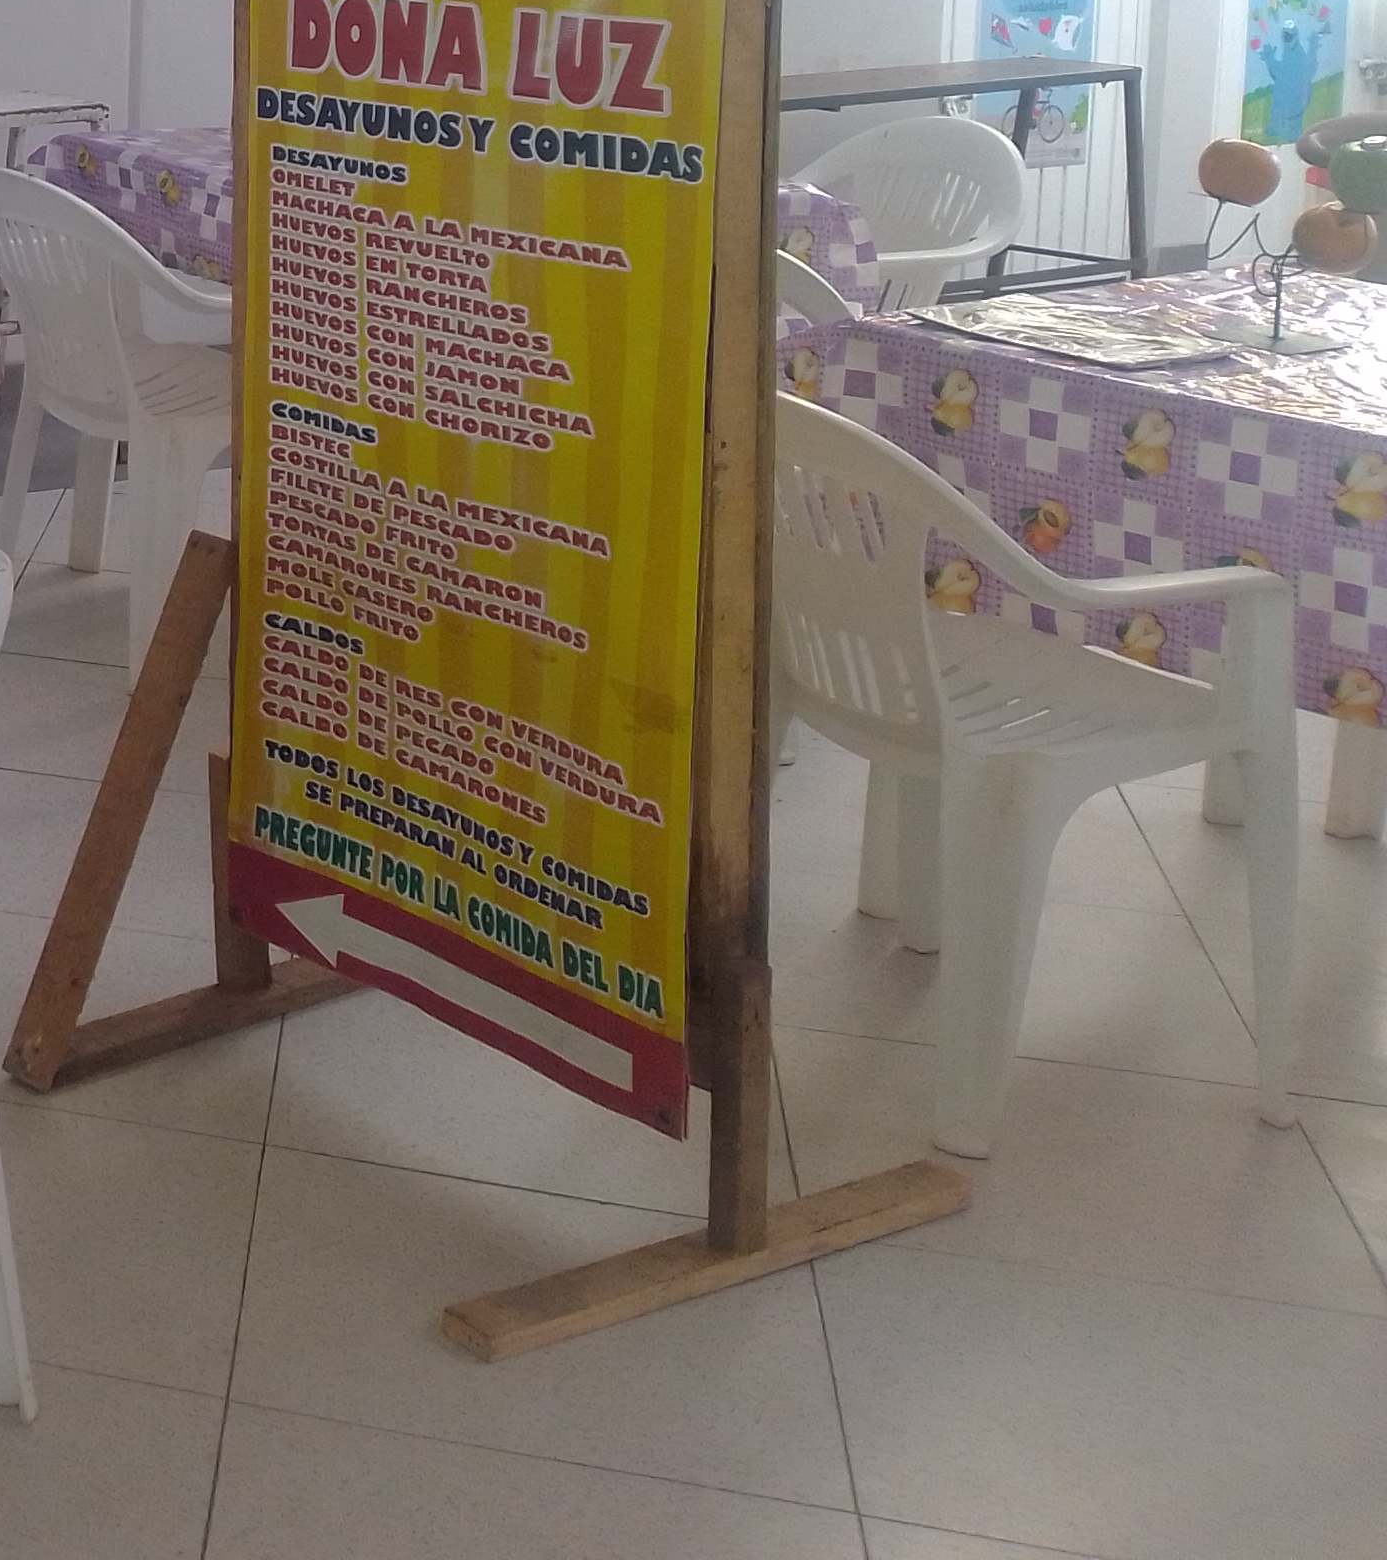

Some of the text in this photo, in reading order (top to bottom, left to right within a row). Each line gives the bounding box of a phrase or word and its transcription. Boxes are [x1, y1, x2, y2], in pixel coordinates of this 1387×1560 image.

[512, 11, 665, 113] LUZ
[257, 87, 703, 183] DESAYUNOS Y COMIDAS
[272, 145, 407, 183] DESAYUNOS
[272, 168, 356, 197] OMELET
[271, 402, 376, 444] COMIDAS
[271, 424, 350, 459] BISTEC
[269, 490, 455, 560] PESCADO FRITO
[264, 613, 364, 655] CALDOS
[254, 805, 664, 1020] PREGUNTE POR LA COMIDA DEL DIA
